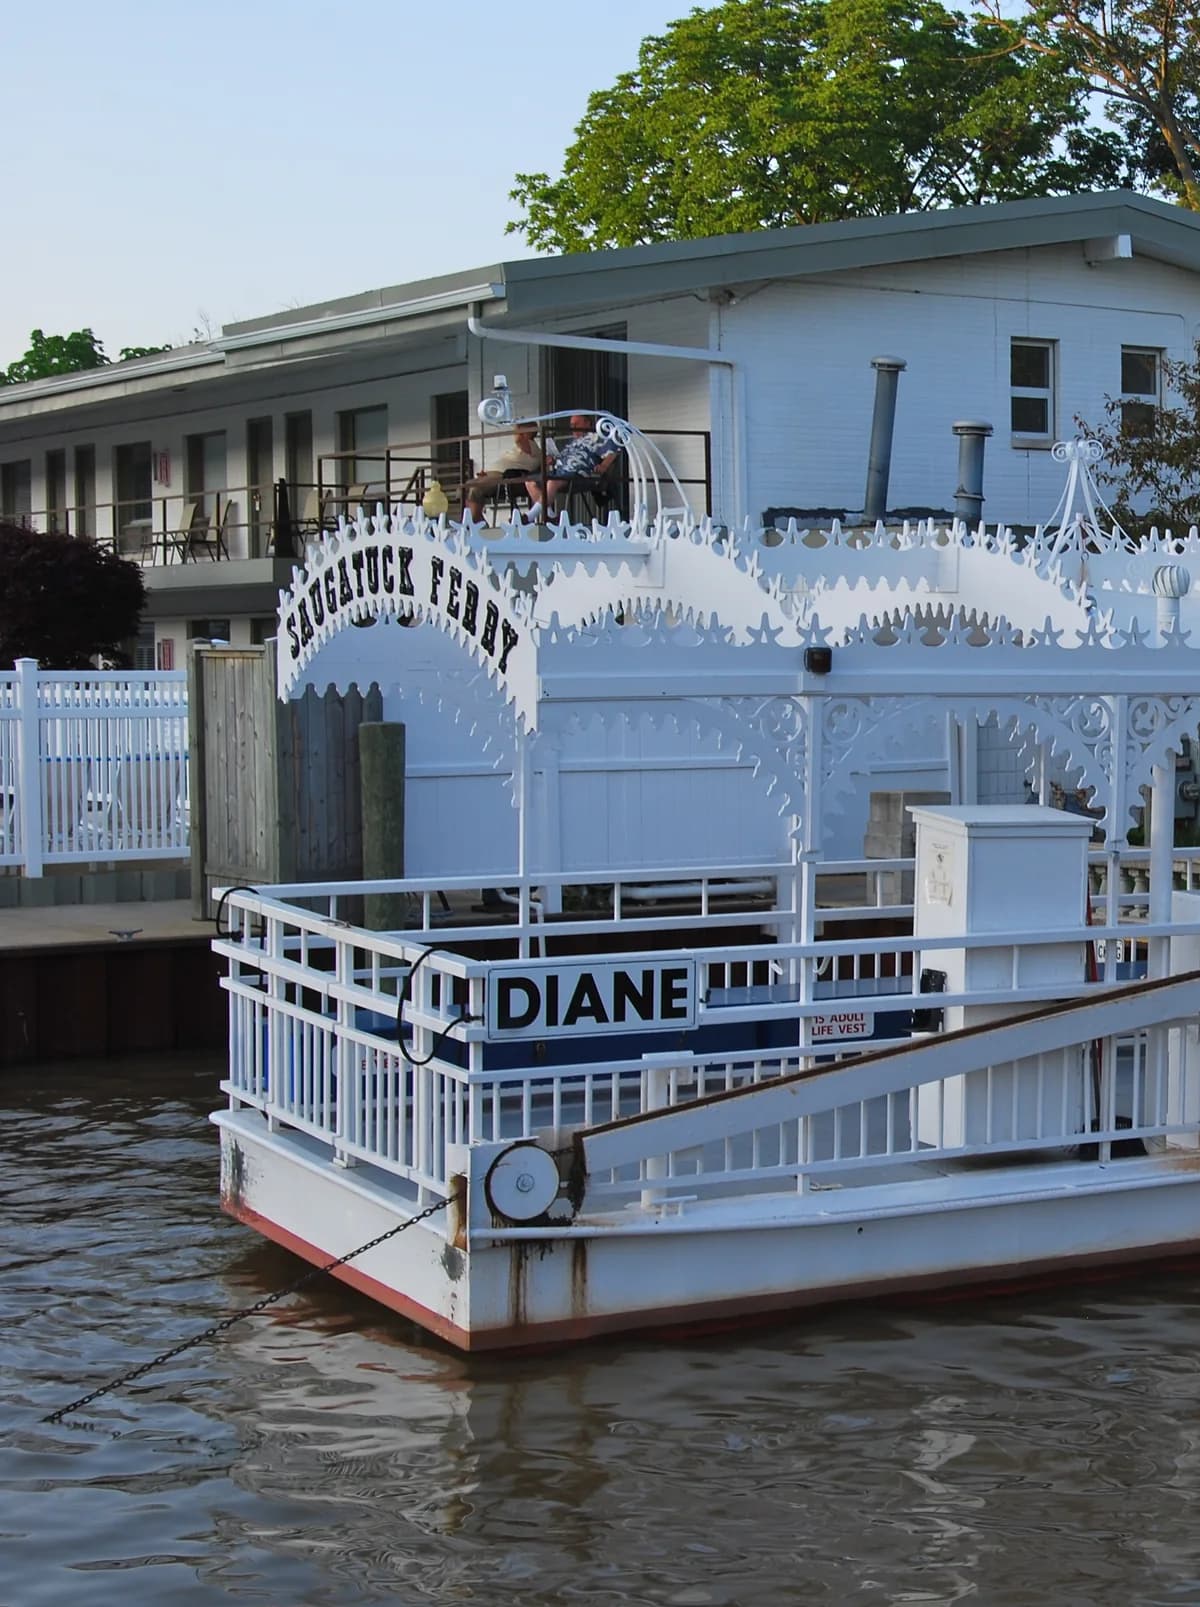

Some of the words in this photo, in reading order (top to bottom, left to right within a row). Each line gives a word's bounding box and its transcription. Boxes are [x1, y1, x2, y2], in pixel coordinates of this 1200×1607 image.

[286, 545, 415, 660] SAUGATUCK
[430, 555, 519, 675] FERRY
[497, 968, 688, 1030] DIANE
[811, 1026, 833, 1036] LIFE
[838, 1023, 866, 1034] VEST
